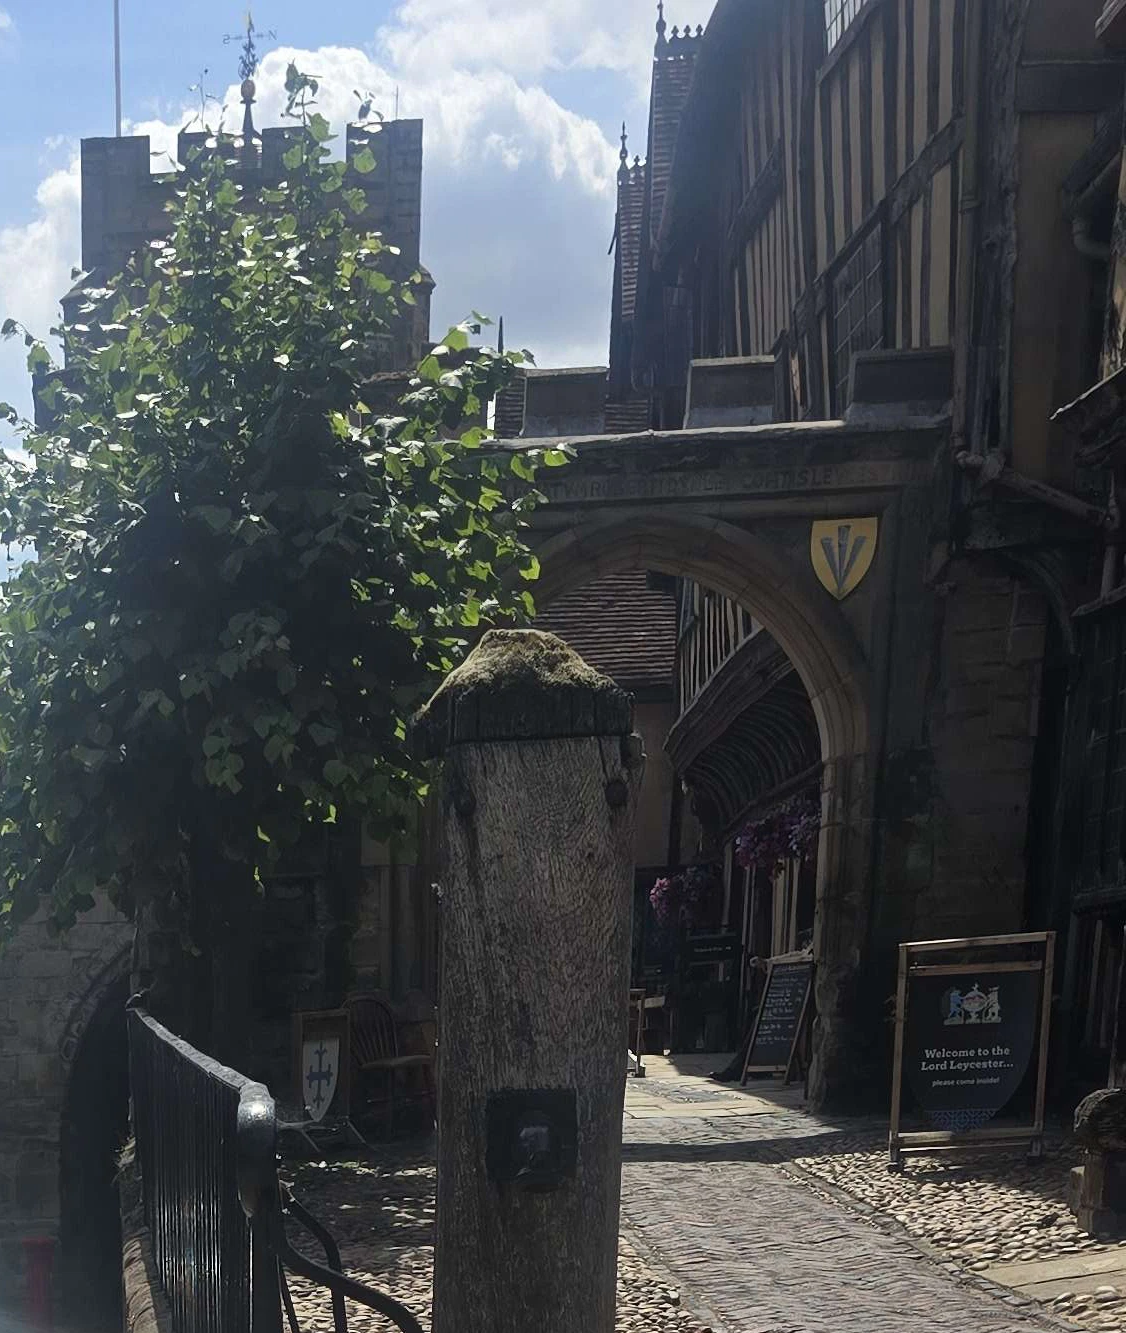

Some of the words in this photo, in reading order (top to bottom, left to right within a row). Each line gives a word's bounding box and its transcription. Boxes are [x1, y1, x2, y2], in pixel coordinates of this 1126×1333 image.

[924, 1048, 976, 1059] Welcome
[977, 1047, 990, 1057] to
[991, 1045, 1011, 1056] the
[920, 1061, 948, 1071] Lord
[949, 1059, 1014, 1072] Leycester...
[932, 1079, 955, 1088] please
